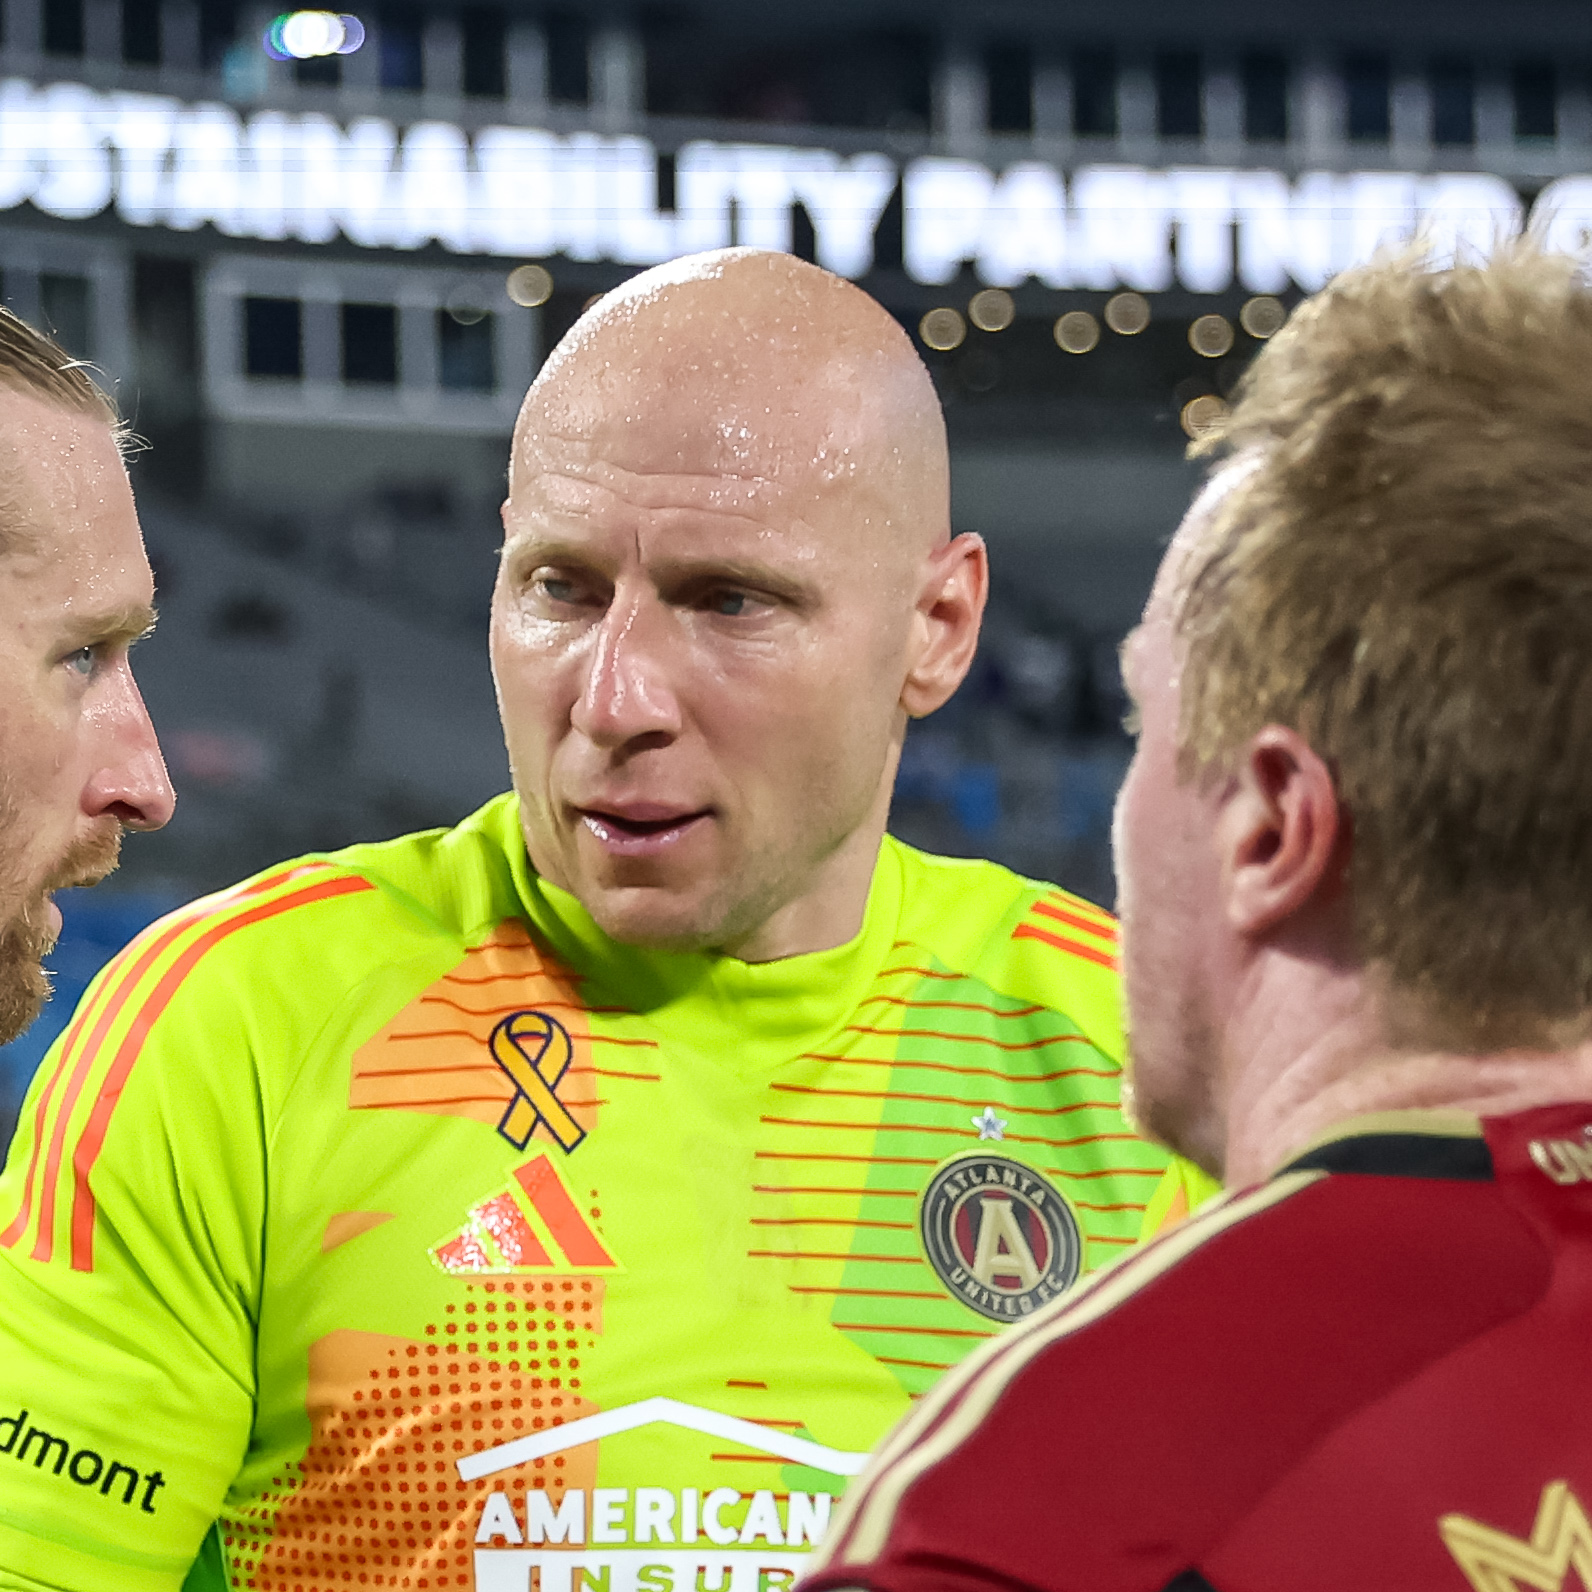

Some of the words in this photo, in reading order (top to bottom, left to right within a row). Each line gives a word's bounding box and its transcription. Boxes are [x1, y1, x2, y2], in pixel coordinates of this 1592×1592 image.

[942, 1164, 1047, 1206] ATLANTA
[949, 1266, 1034, 1315] UNITED
[475, 1486, 833, 1547] AMERICAN
